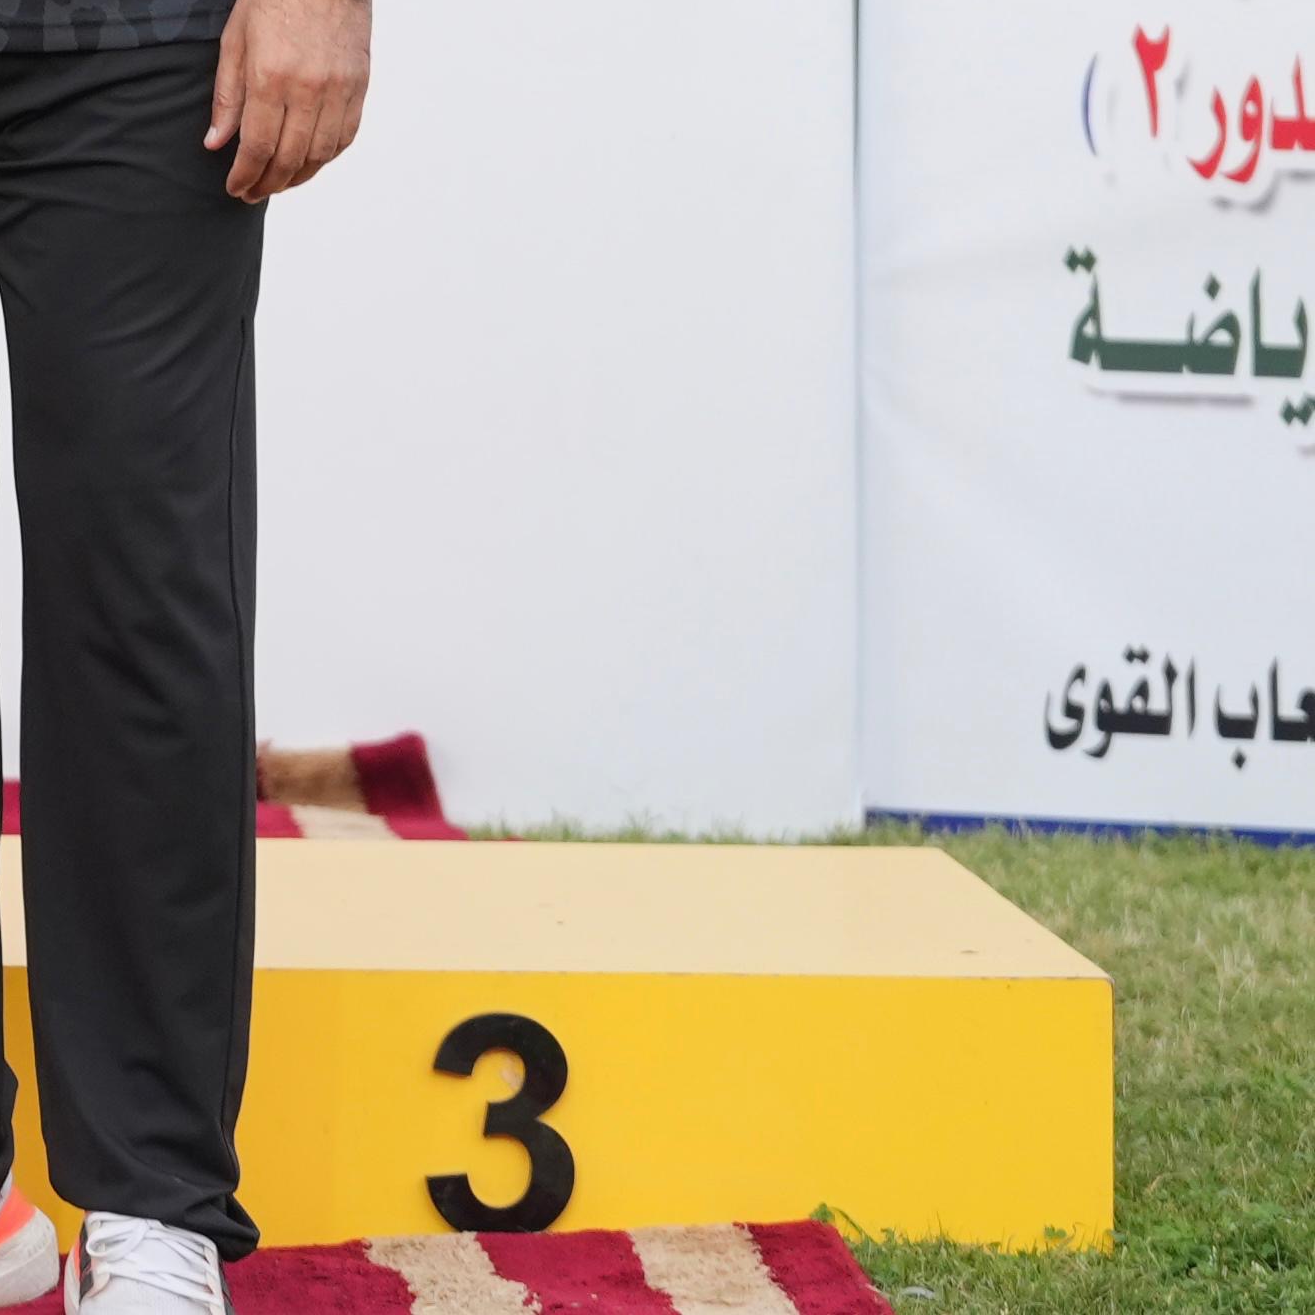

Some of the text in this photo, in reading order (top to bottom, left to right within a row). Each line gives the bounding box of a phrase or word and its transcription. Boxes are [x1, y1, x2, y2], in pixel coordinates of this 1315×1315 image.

[1186, 52, 1315, 184] دور
[1063, 244, 1315, 427] ياضة
[1045, 644, 1196, 759] القوى
[426, 1011, 575, 1233] 3
